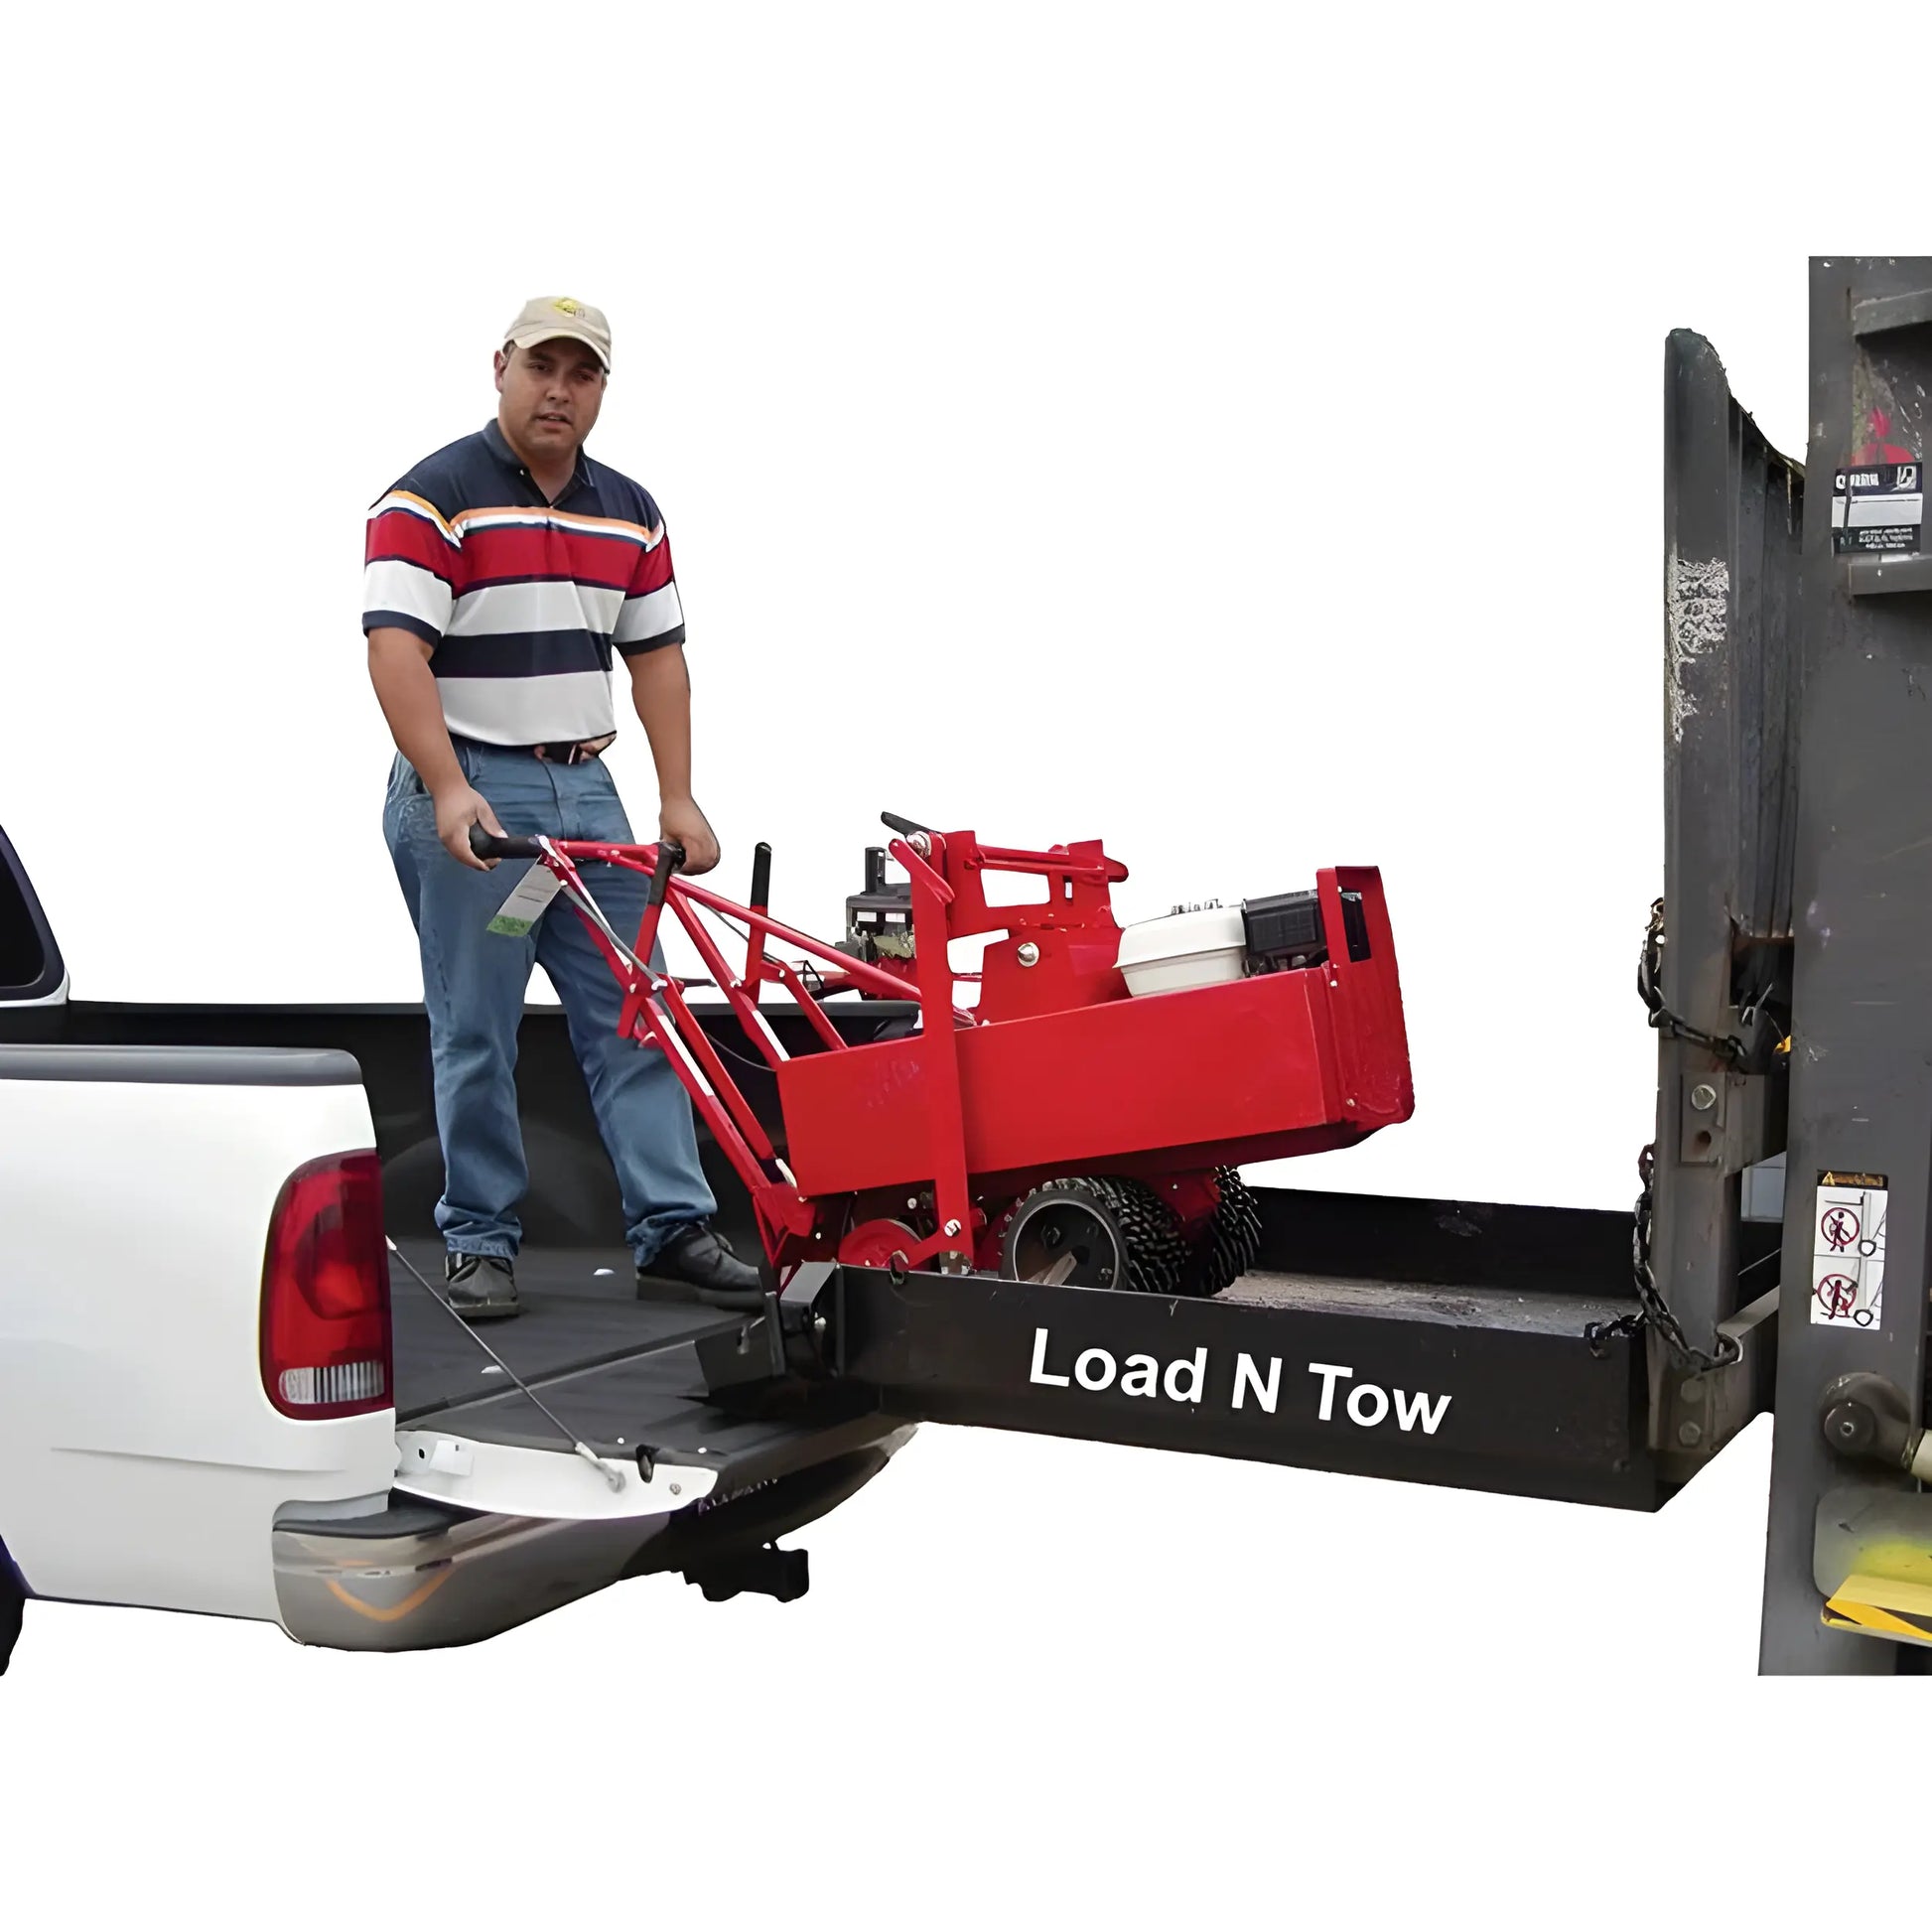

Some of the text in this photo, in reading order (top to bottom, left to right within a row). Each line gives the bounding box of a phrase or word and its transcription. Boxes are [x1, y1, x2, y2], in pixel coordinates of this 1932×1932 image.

[1030, 1327, 1452, 1435] Load N Tow
